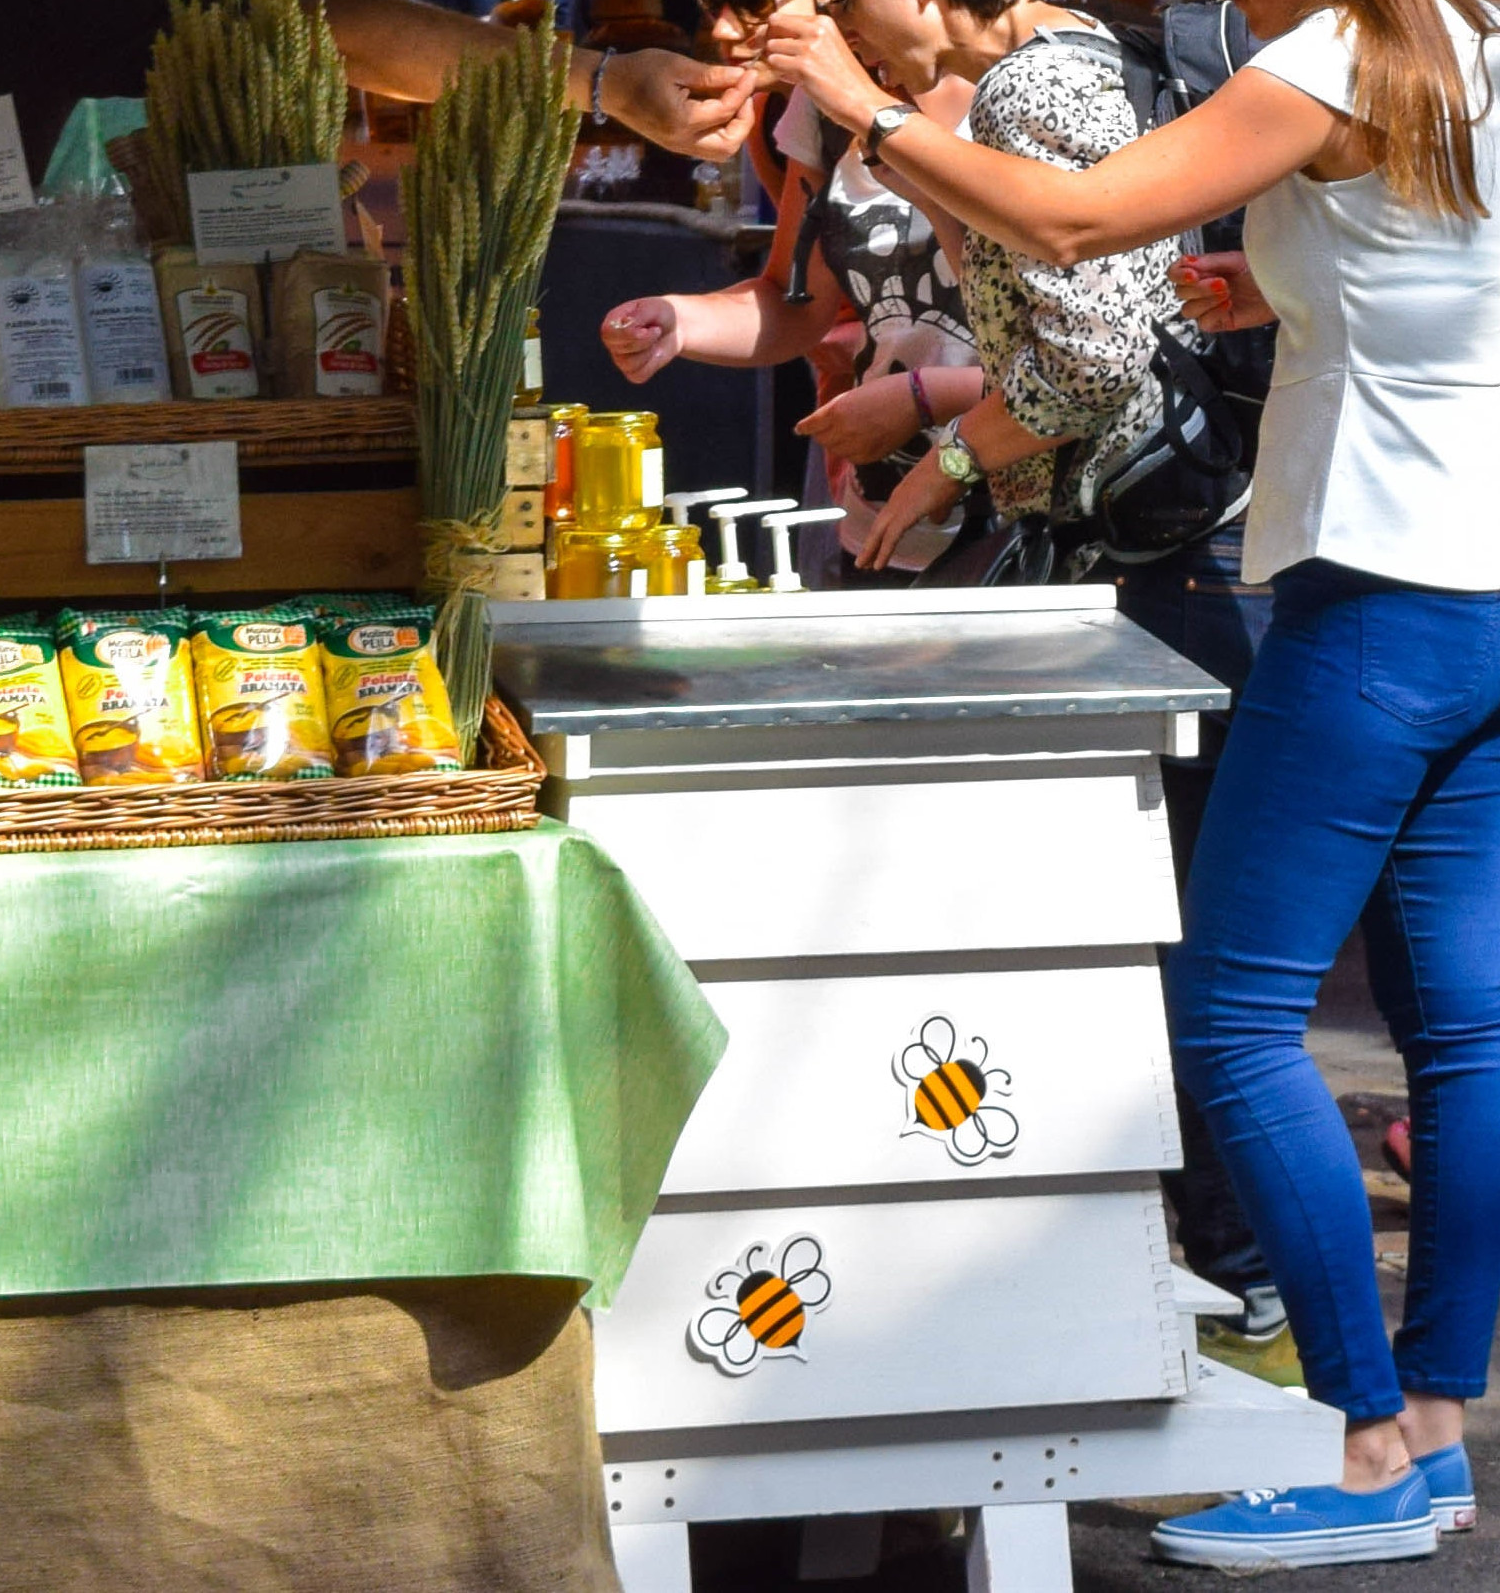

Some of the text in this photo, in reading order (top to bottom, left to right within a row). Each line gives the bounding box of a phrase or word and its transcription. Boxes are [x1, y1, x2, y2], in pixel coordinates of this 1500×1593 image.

[242, 671, 301, 683] Polenta
[358, 672, 417, 687] Polenta
[239, 681, 307, 695] BRAMATA
[357, 682, 424, 699] BRAMATA
[101, 696, 170, 712] BRAATA
